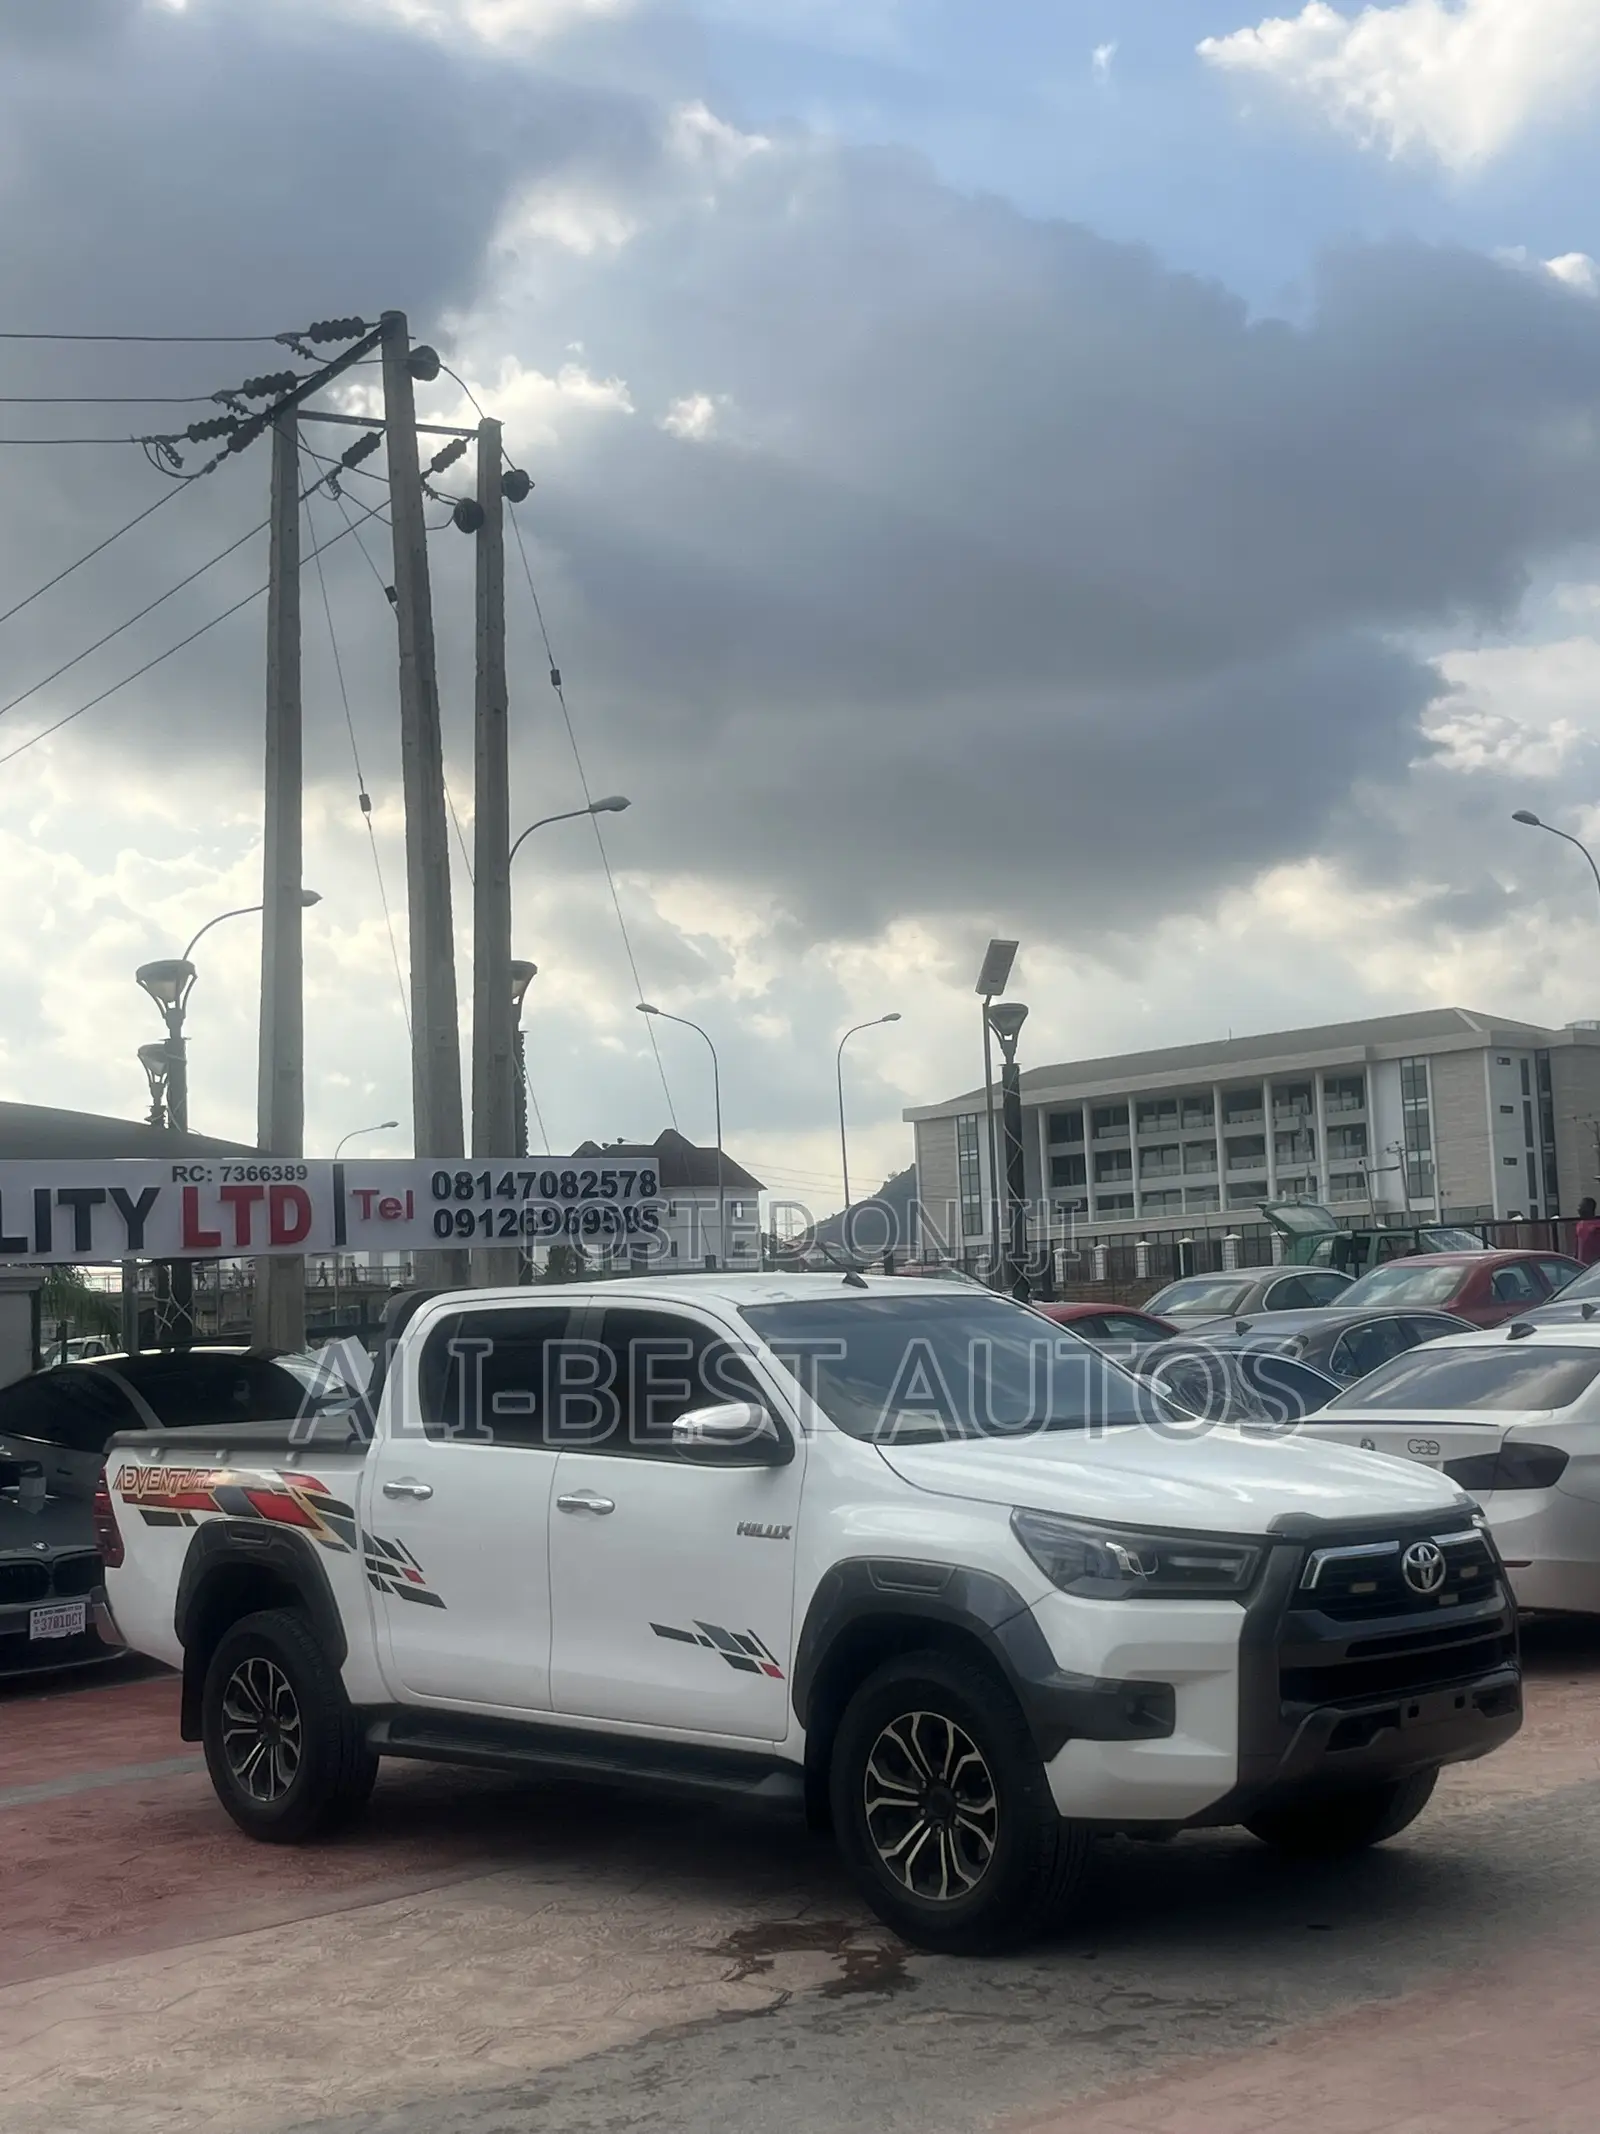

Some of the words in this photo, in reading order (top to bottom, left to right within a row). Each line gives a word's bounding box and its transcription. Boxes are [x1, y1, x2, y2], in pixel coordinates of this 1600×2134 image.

[171, 1165, 213, 1183] RC:
[219, 1164, 309, 1182] 7366389
[431, 1169, 658, 1201] 08147082578
[182, 1185, 312, 1248] LTD
[351, 1189, 414, 1220] Tel
[112, 1464, 220, 1495] ADVENTURE
[736, 1520, 793, 1541] HILUX
